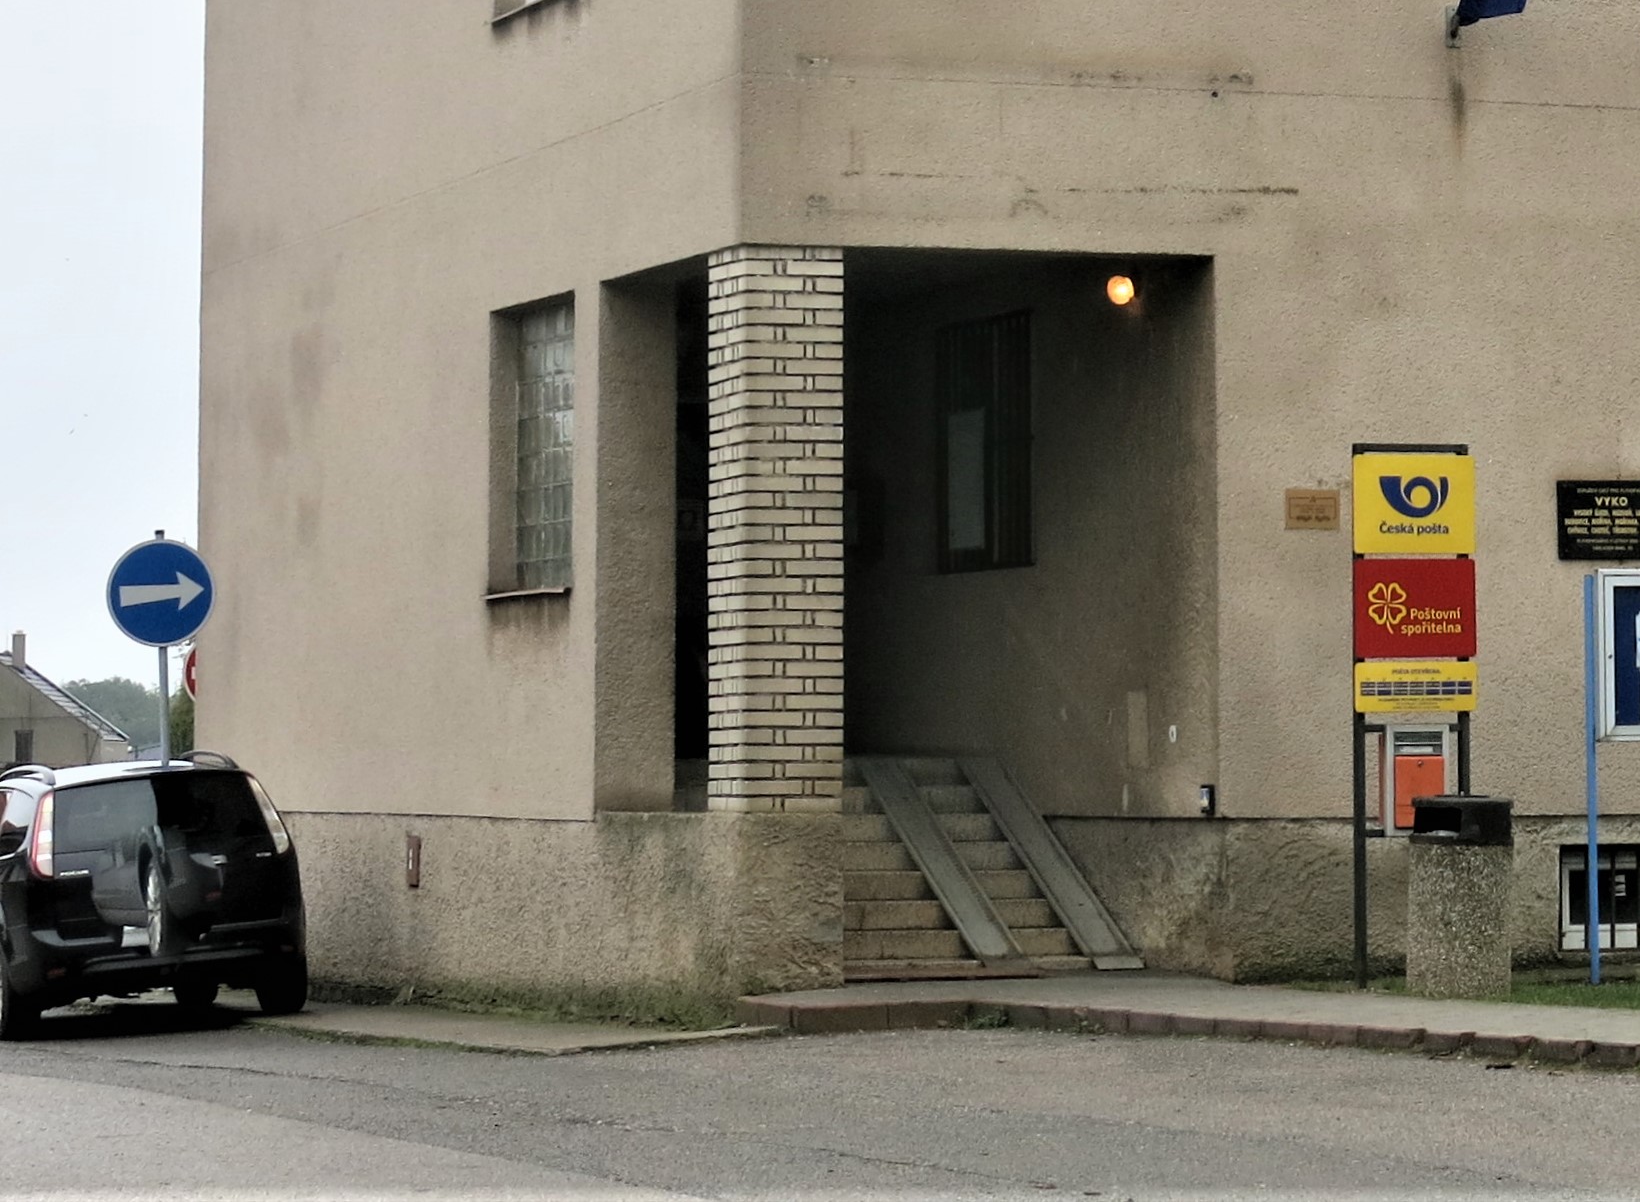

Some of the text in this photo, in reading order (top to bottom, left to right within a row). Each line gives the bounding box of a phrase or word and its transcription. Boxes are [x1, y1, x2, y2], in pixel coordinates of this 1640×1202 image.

[1594, 496, 1629, 507] VYKO
[1378, 519, 1450, 536] Česká pošta
[1409, 606, 1462, 620] Poštovní
[1400, 621, 1462, 636] spořitelna
